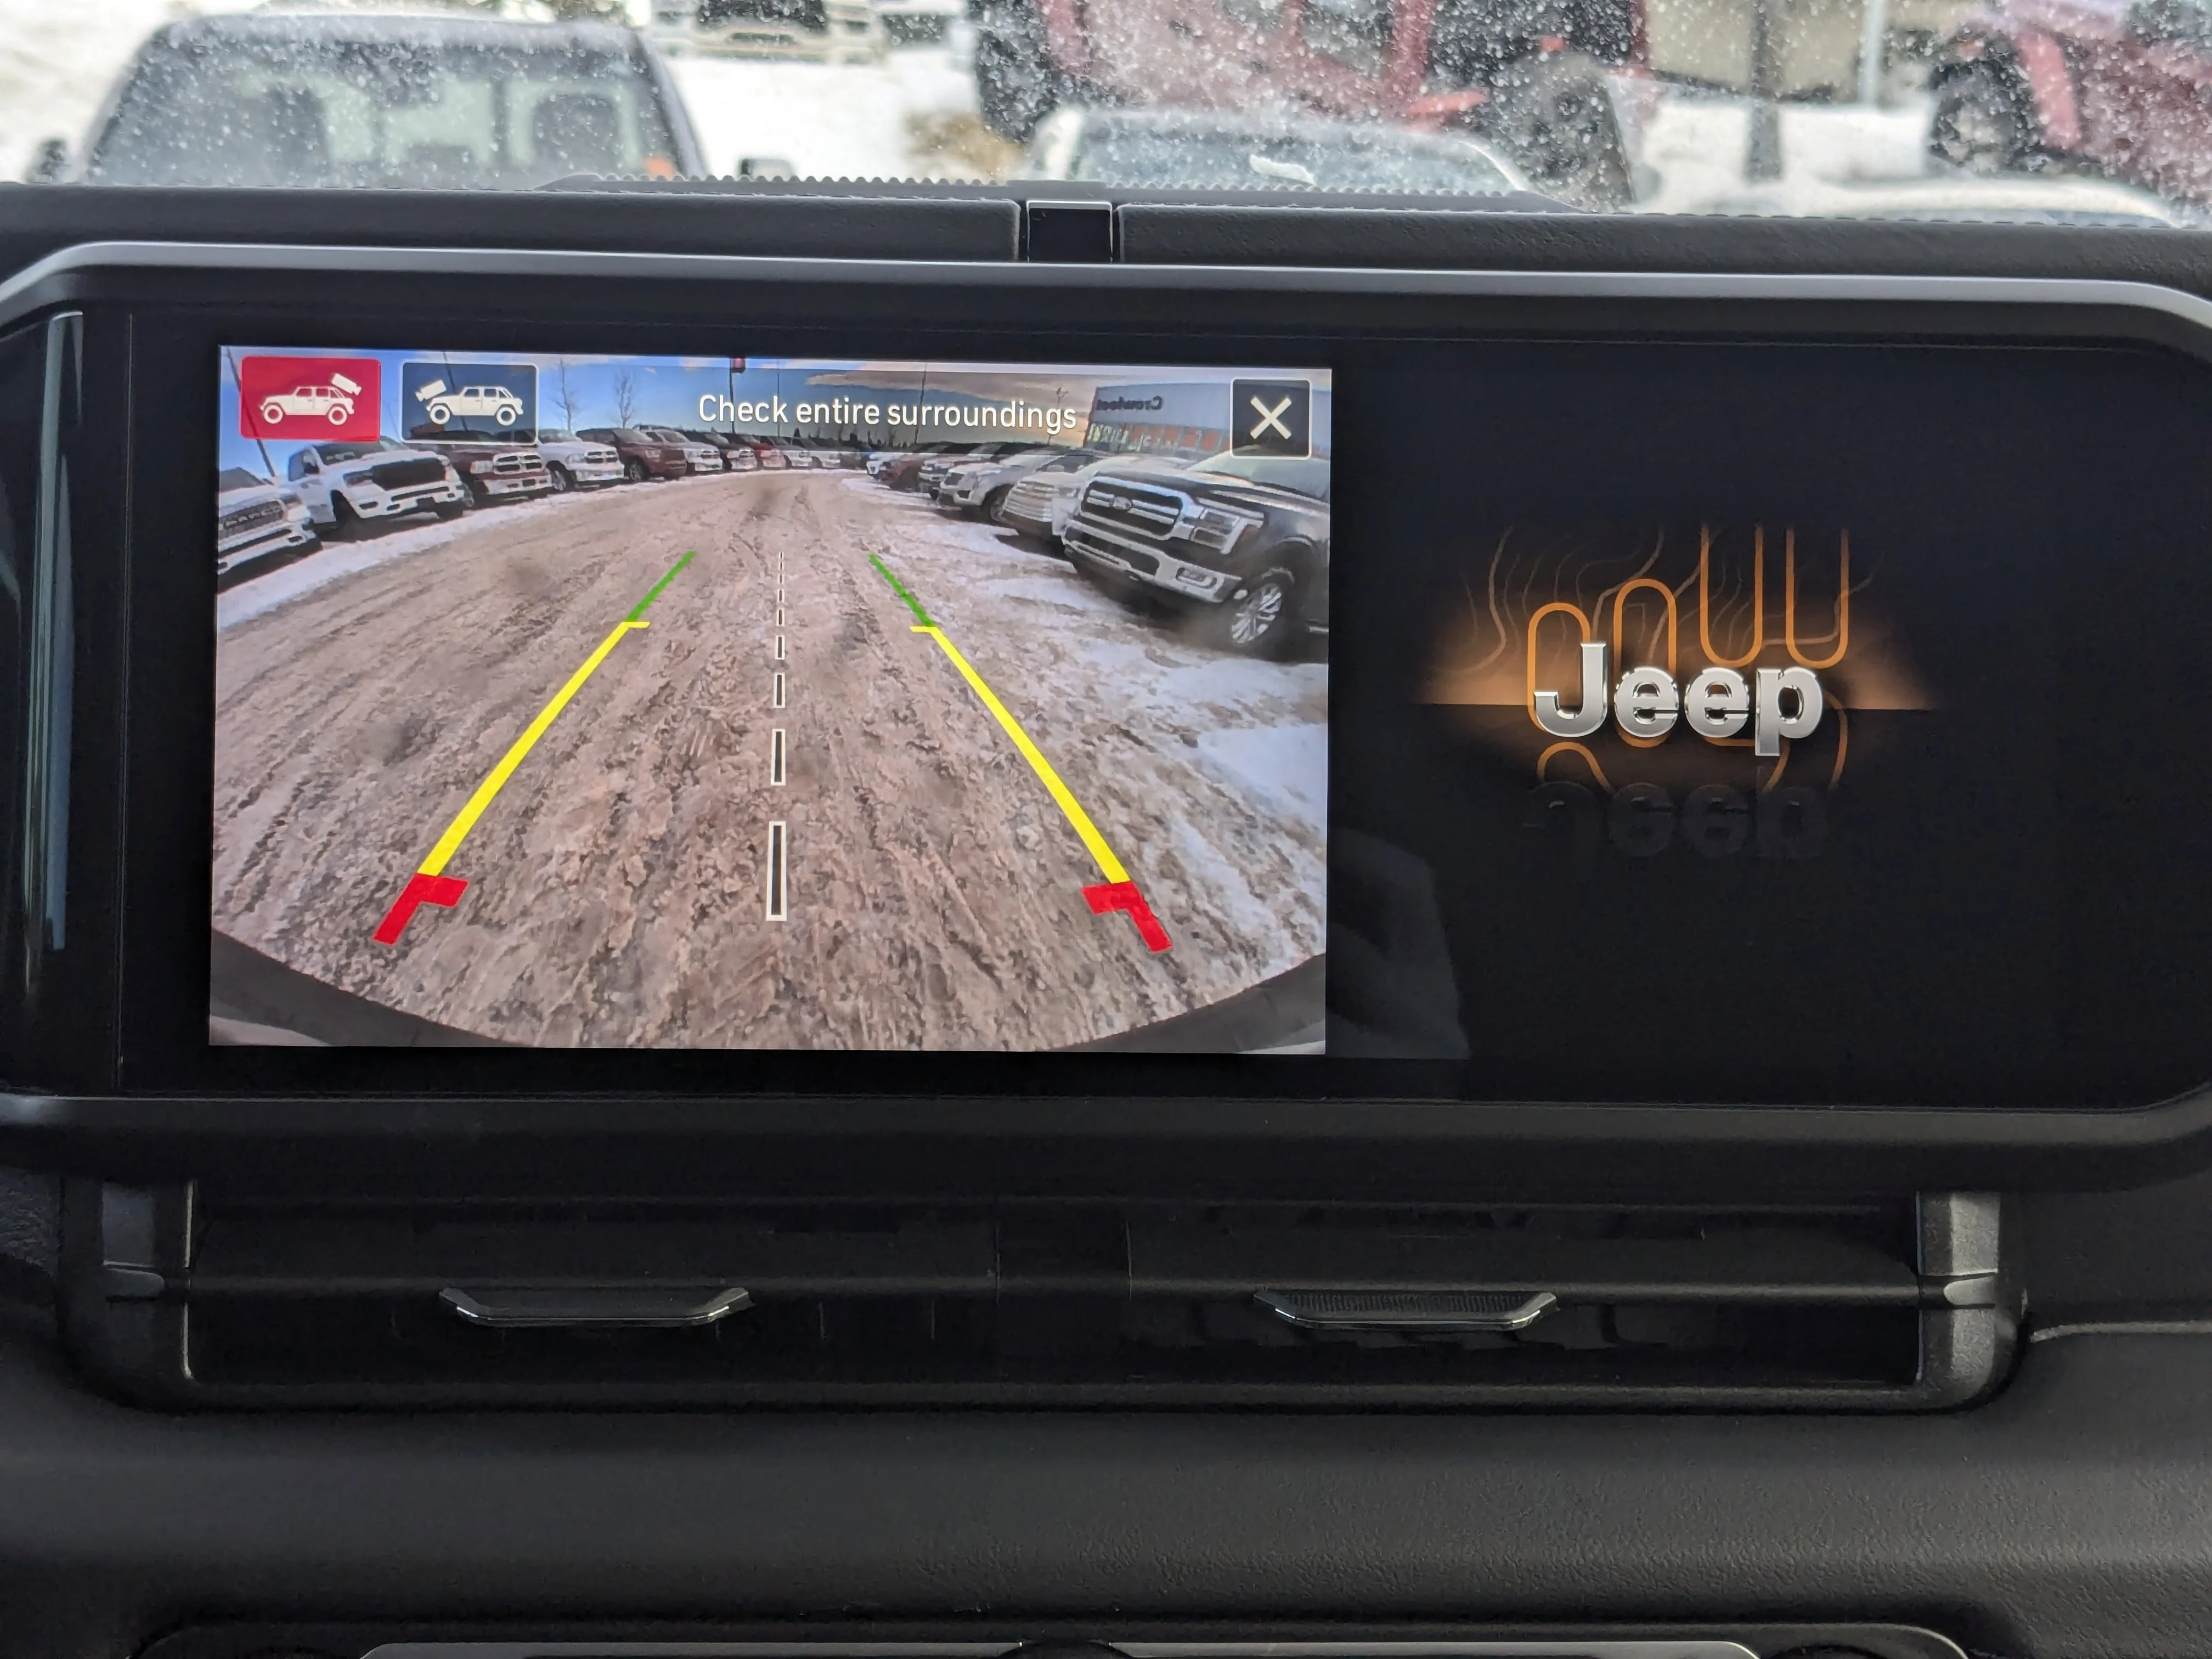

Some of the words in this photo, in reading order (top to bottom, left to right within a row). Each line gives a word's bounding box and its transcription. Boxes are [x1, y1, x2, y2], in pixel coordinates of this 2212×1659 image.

[699, 394, 788, 422] Check
[796, 397, 879, 425] entire
[887, 400, 1077, 435] surroundings
[1533, 641, 1824, 756] Jeep
